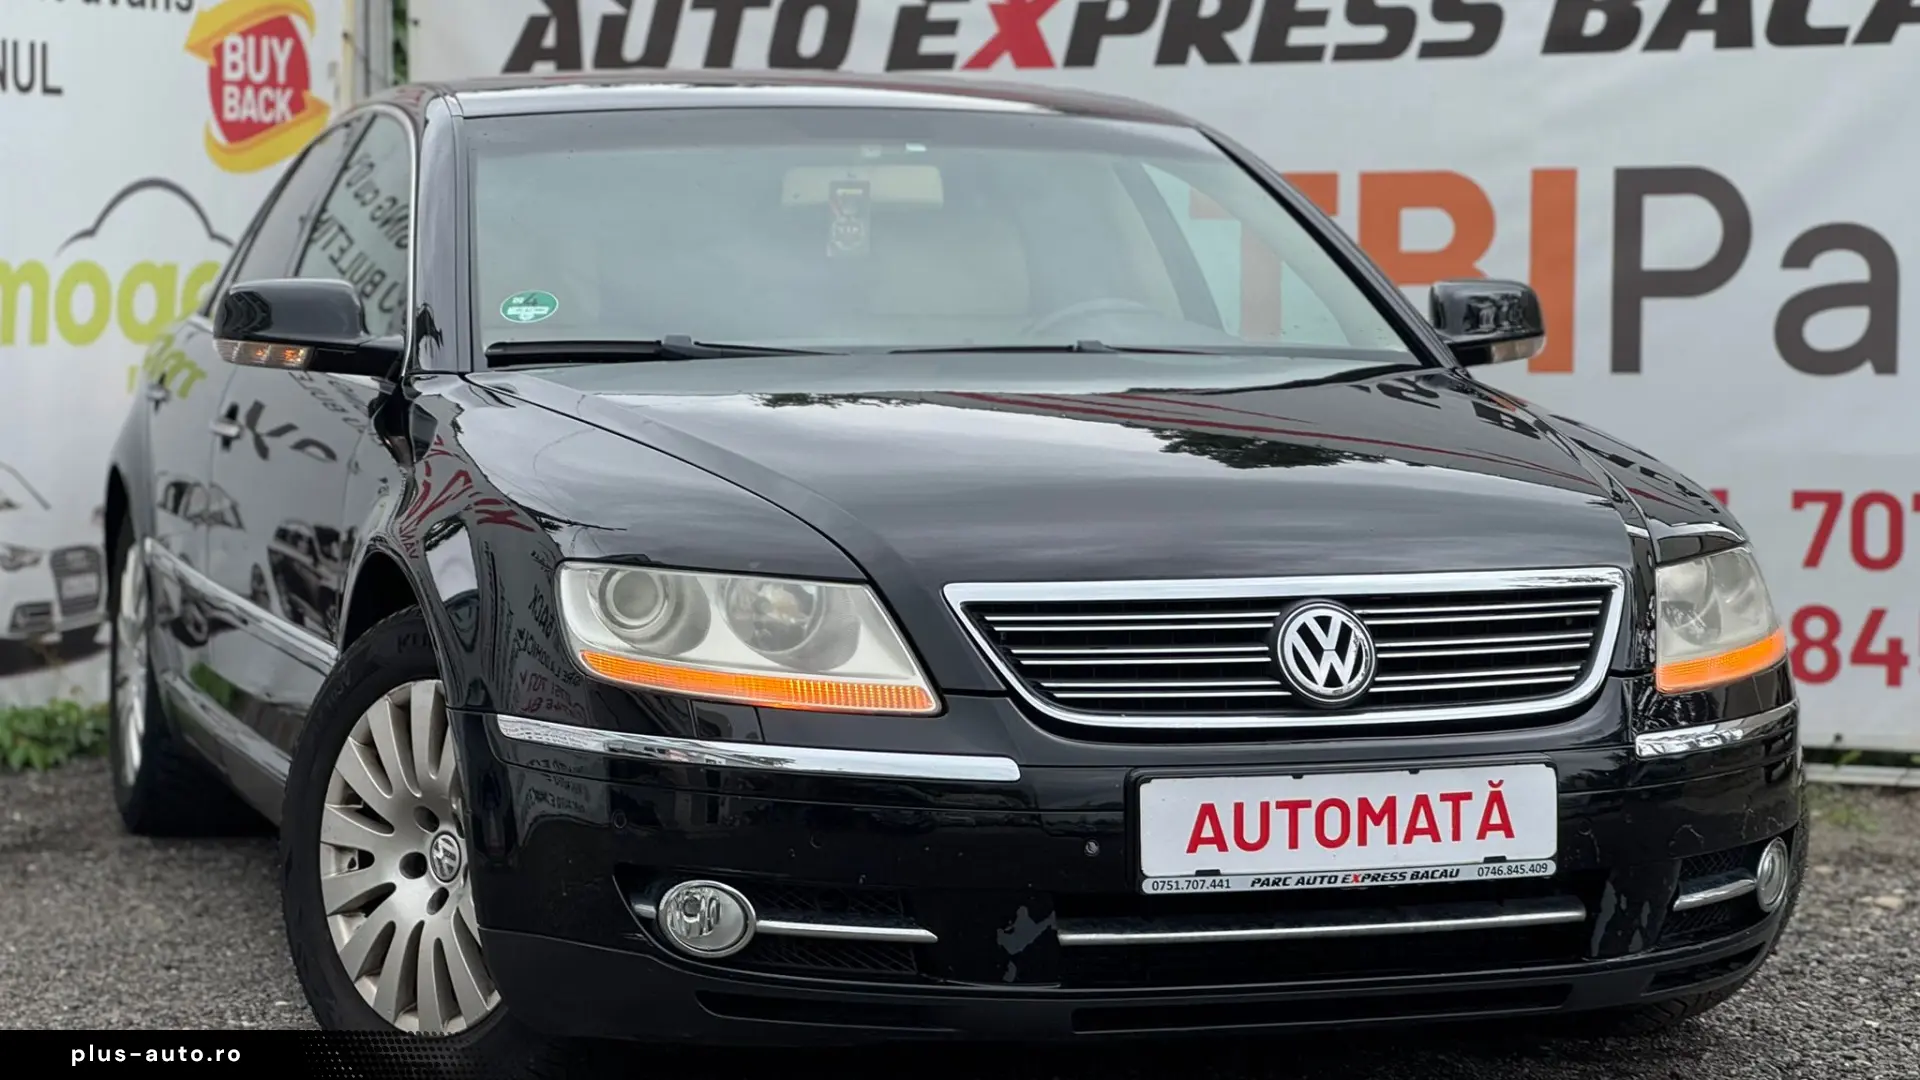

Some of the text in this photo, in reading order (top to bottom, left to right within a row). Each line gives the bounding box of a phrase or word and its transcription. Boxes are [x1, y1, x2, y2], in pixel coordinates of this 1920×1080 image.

[221, 34, 294, 84] BUY
[502, 0, 857, 74] AUTO
[886, 0, 1505, 72] EXPRESS
[221, 86, 293, 123] BACK
[1791, 488, 1920, 571] 70
[1789, 603, 1920, 688] 84
[1186, 779, 1516, 855] AUTOMATĂ
[1151, 878, 1231, 892] 0751.707.441
[1250, 876, 1292, 888] PARC
[1294, 874, 1339, 886] AUTO
[1341, 871, 1408, 884] EXPRESS
[1477, 862, 1549, 878] 0746.845.409
